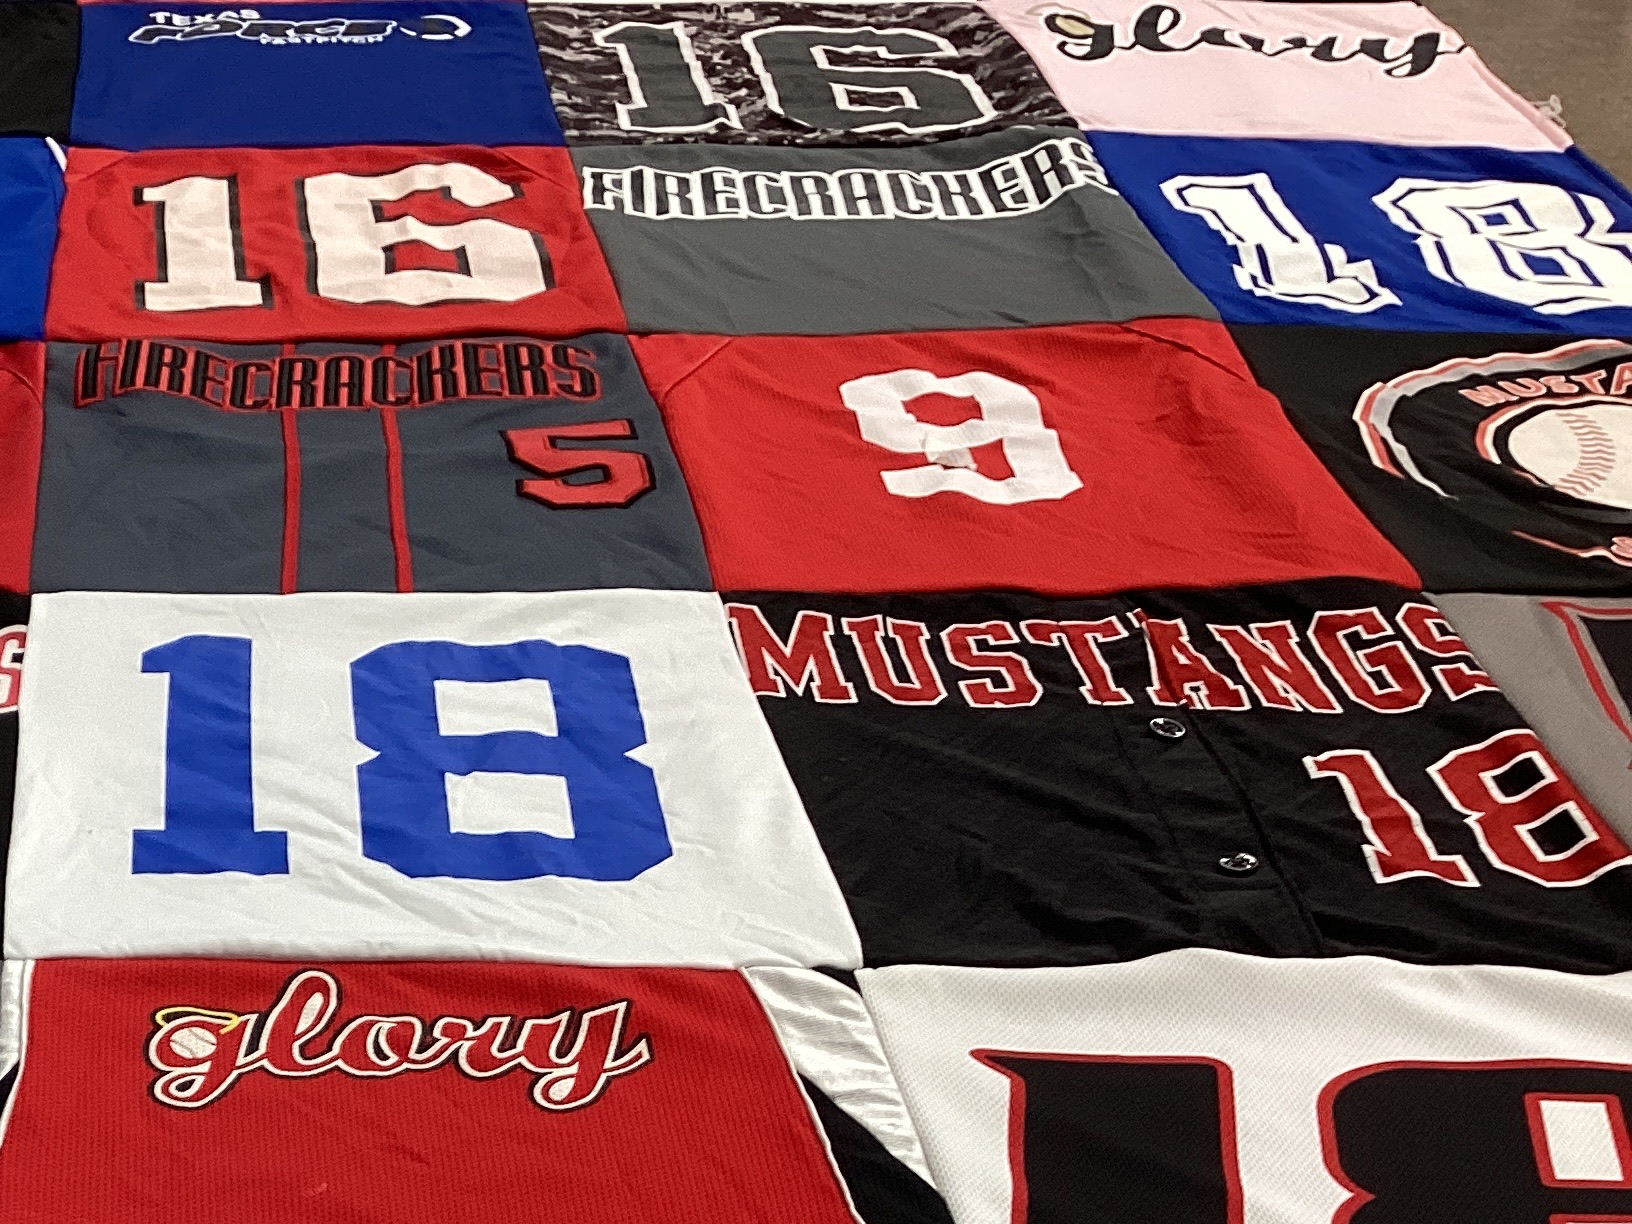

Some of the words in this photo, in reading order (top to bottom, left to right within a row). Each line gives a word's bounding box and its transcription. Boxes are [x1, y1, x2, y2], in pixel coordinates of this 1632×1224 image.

[592, 20, 998, 134] 16
[135, 163, 556, 312] 16
[1160, 173, 1632, 315] 18
[74, 337, 603, 412] FIRECRACKERS
[839, 369, 1084, 504] 9
[498, 417, 657, 510] 5
[724, 600, 1503, 713] MUSTANGS
[131, 634, 674, 882] 18
[1302, 729, 1632, 887] 18
[147, 969, 653, 1109] glory
